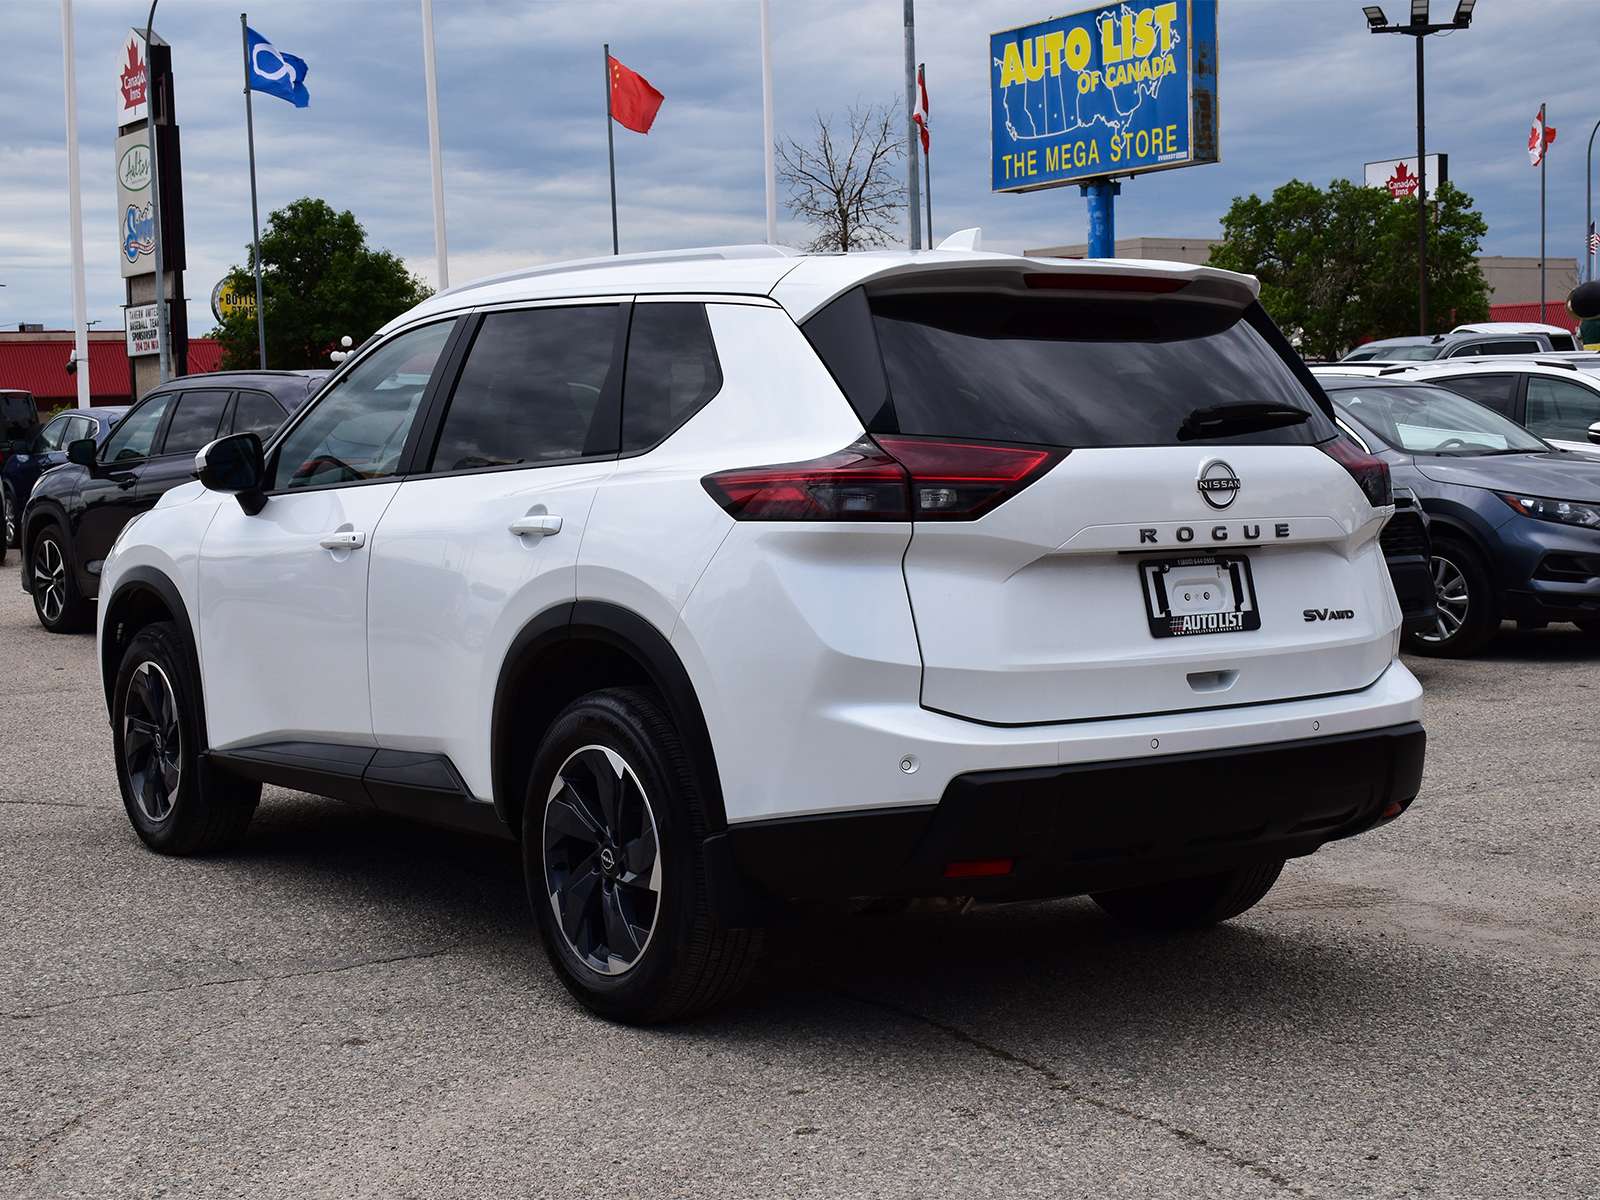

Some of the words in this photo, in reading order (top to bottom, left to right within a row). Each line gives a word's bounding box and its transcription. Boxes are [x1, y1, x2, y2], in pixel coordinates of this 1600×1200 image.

[1000, 27, 1091, 88] AUTO
[1102, 2, 1177, 65] LIST
[1077, 72, 1100, 94] OF
[1105, 53, 1176, 88] CANADA
[1002, 150, 1038, 179] THE
[1046, 139, 1100, 173] MEGA
[1110, 124, 1177, 162] STORE
[1396, 188, 1409, 196] Inns
[1199, 480, 1240, 490] NISSAN
[1139, 523, 1290, 544] ROGUE
[1303, 608, 1328, 622] SV
